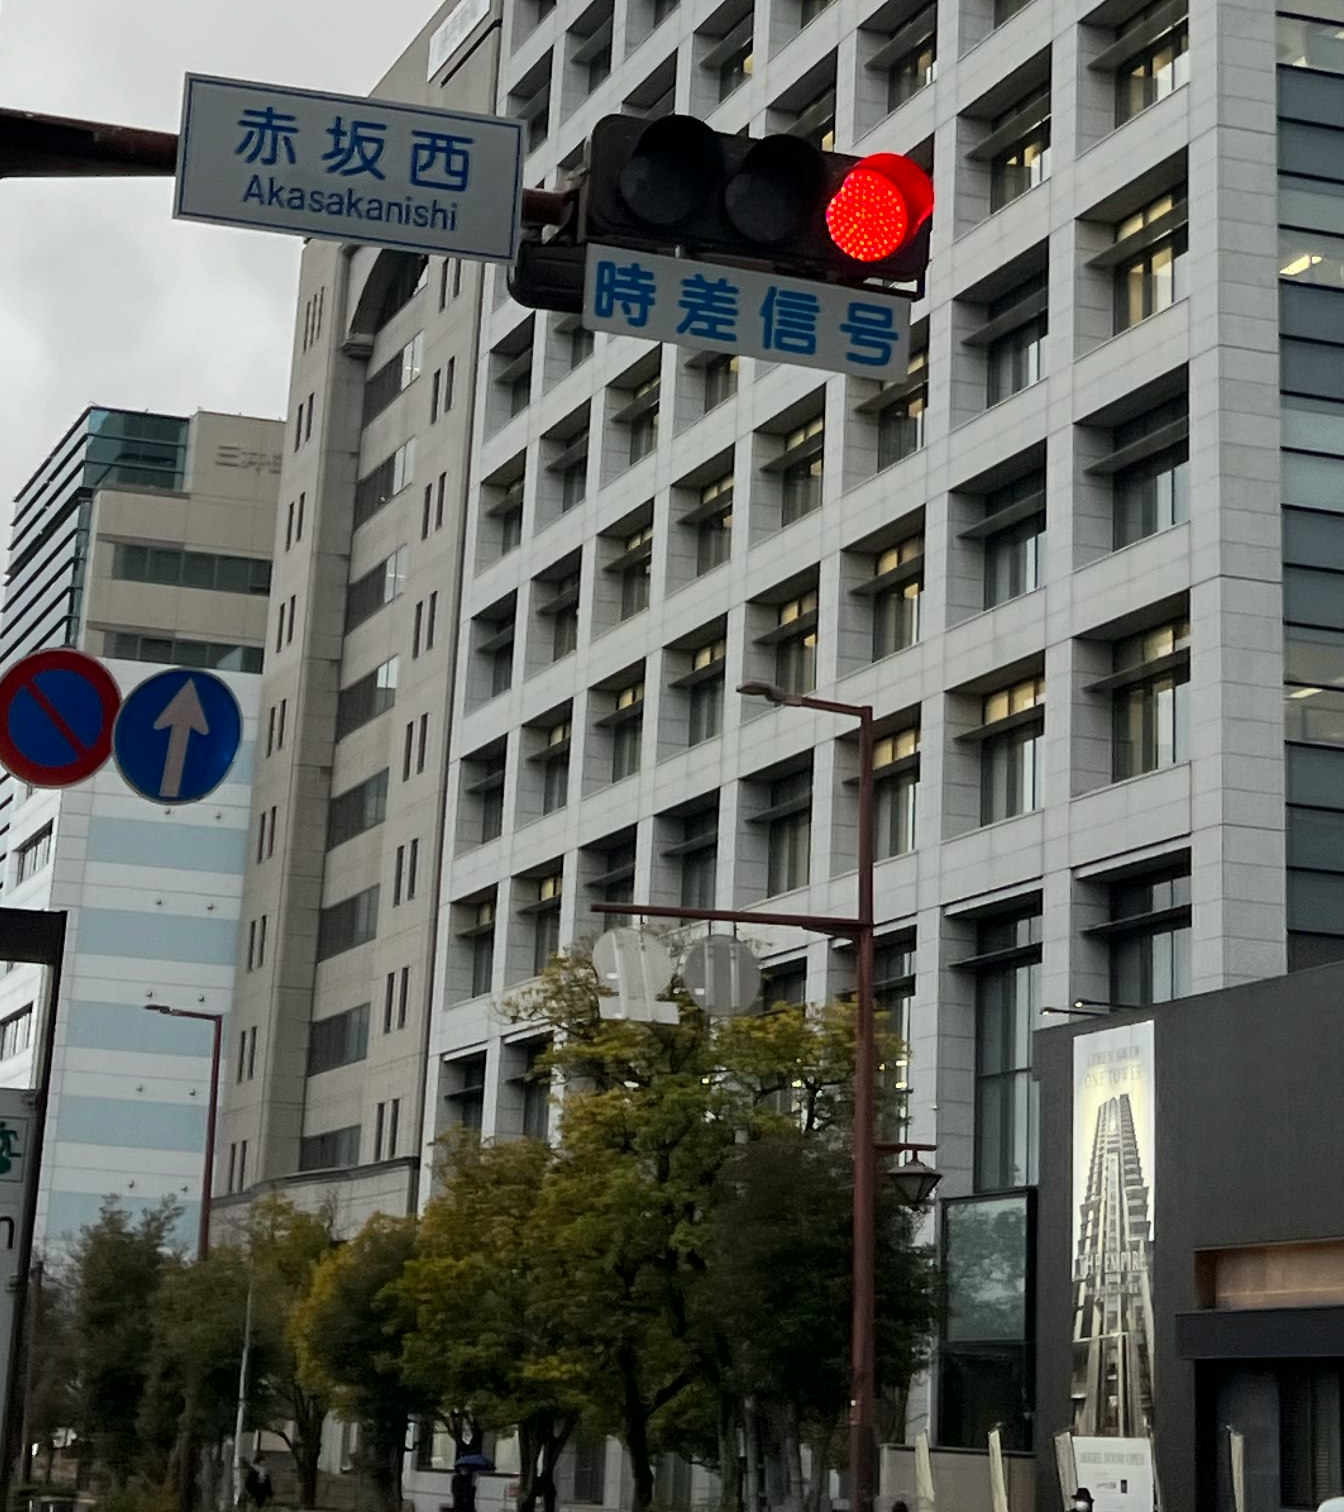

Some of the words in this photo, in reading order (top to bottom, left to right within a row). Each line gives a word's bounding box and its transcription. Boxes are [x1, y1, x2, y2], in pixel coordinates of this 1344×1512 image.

[235, 106, 474, 192] 赤坂西
[241, 174, 458, 231] Akasakanishi
[594, 261, 899, 366] 時差信号
